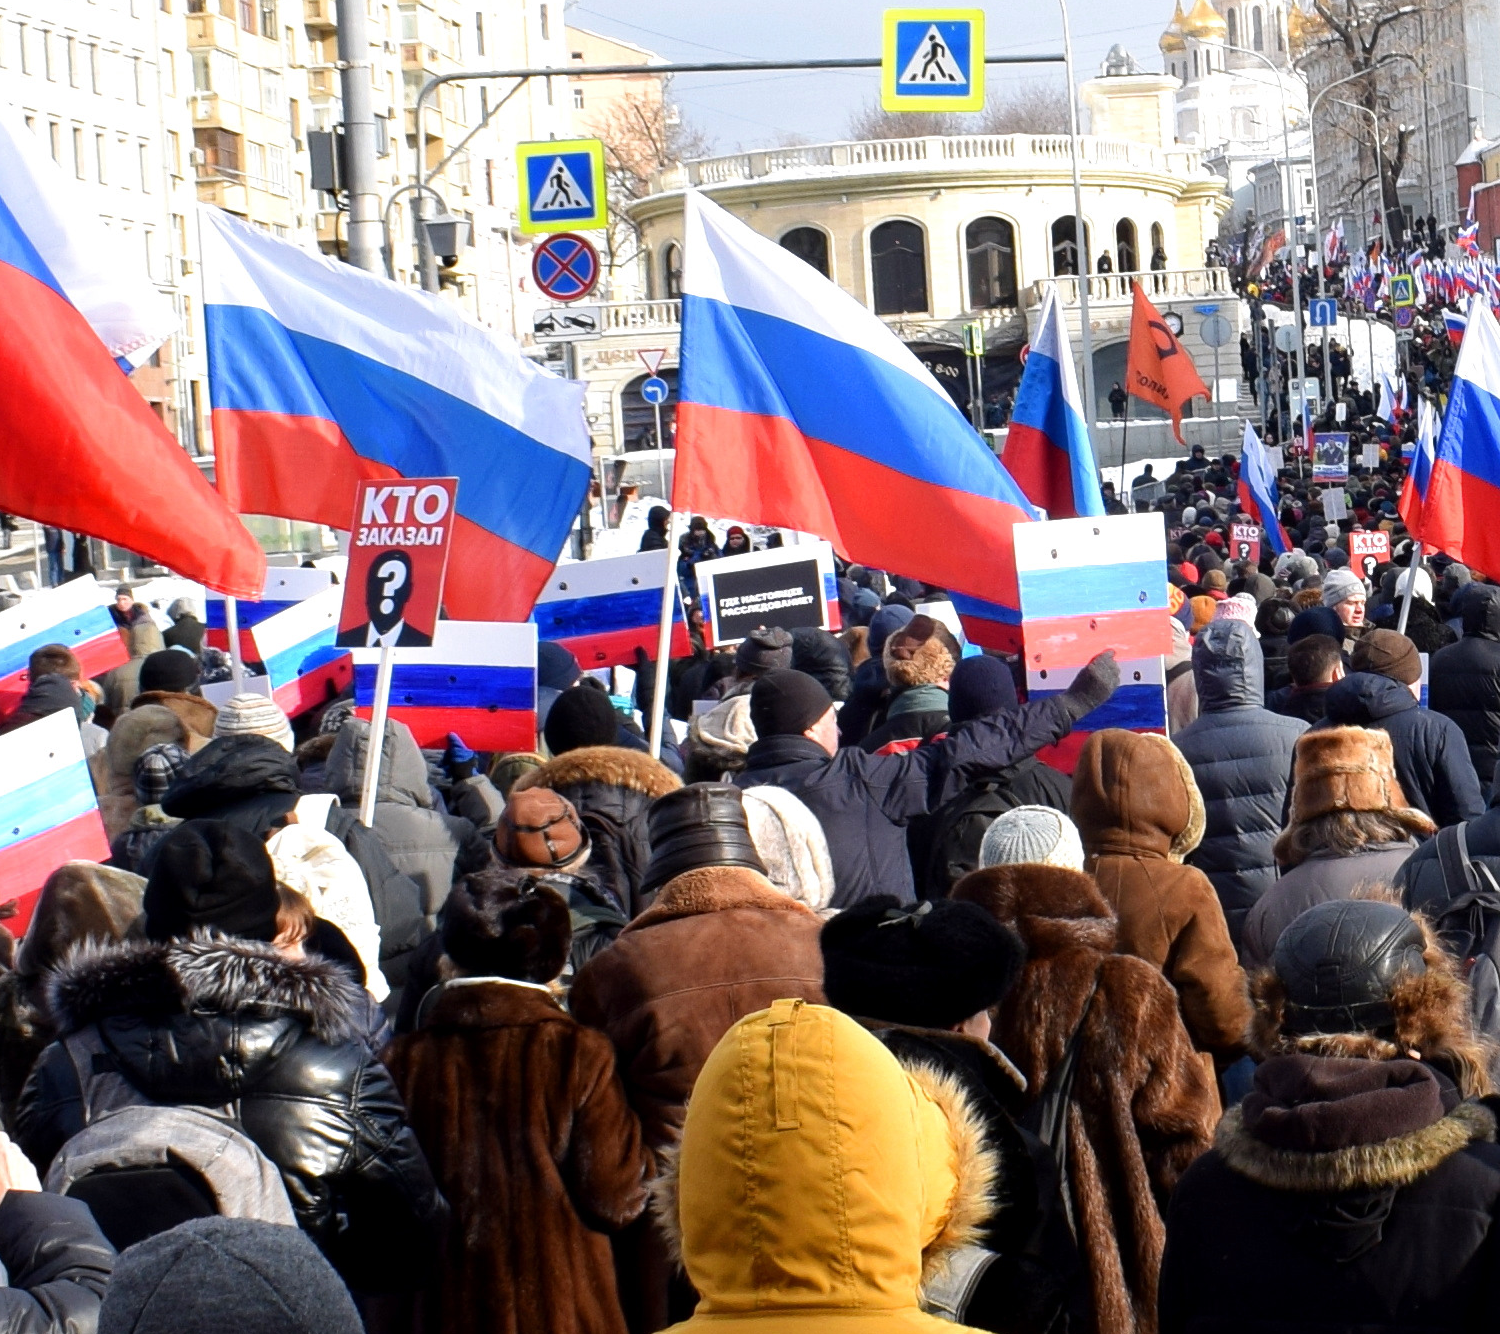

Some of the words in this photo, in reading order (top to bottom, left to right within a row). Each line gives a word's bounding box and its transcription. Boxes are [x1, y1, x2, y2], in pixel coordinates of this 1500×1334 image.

[361, 485, 449, 525] КТО
[356, 527, 443, 546] ЗАКАЗАЛ
[1233, 524, 1259, 537] КТО
[1352, 532, 1387, 548] КТО
[377, 560, 407, 615] ?
[719, 596, 739, 608] ГДЕ
